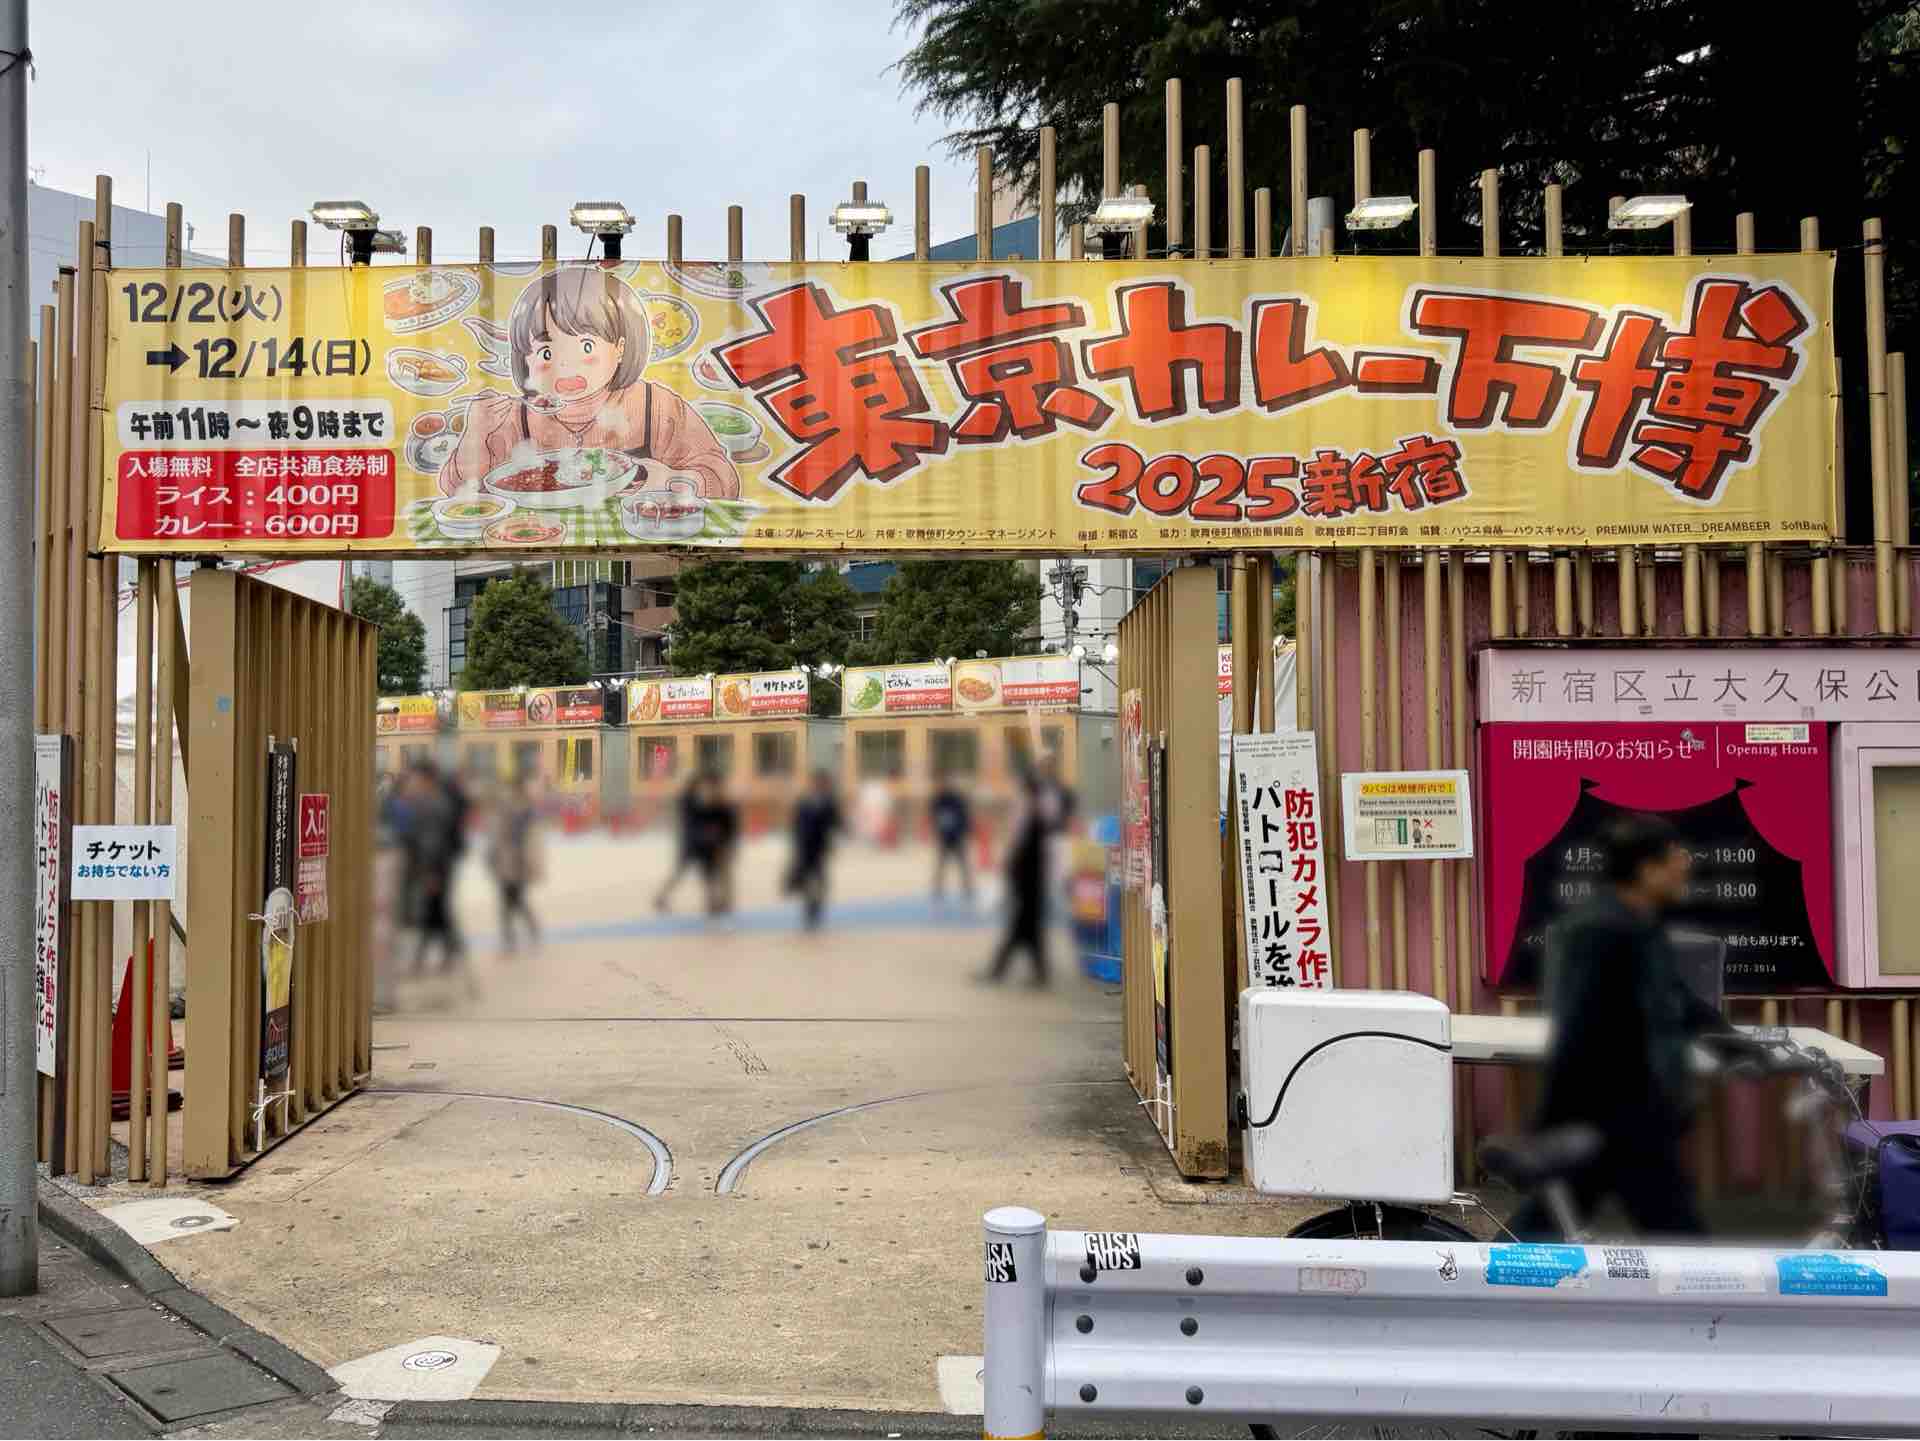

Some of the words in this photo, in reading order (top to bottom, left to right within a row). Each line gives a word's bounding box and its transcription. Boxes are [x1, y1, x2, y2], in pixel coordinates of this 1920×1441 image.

[122, 282, 282, 324] 12/2(火)
[193, 337, 372, 378] 12/14(日)
[711, 275, 1809, 502] 東京カレー万博
[126, 456, 212, 478] 入場無料
[235, 454, 389, 477] 全店共通食券制
[1078, 435, 1467, 520] 2025新宿
[1596, 525, 1648, 536] PREMIUM
[1652, 524, 1691, 535] WATER
[1702, 522, 1771, 533] DREAMBEER
[1511, 668, 1920, 703] 新宿区立大久保公
[1513, 738, 1694, 761] 開園時間のお知らせ
[1726, 743, 1778, 757] Opening
[1782, 742, 1819, 755] Hours
[86, 840, 161, 859] チケット
[77, 864, 170, 879] お持ちでない方
[1284, 789, 1329, 989] 防犯カメラ作
[1085, 1233, 1139, 1254] GUSA
[1605, 1258, 1648, 1267] ACTIVE
